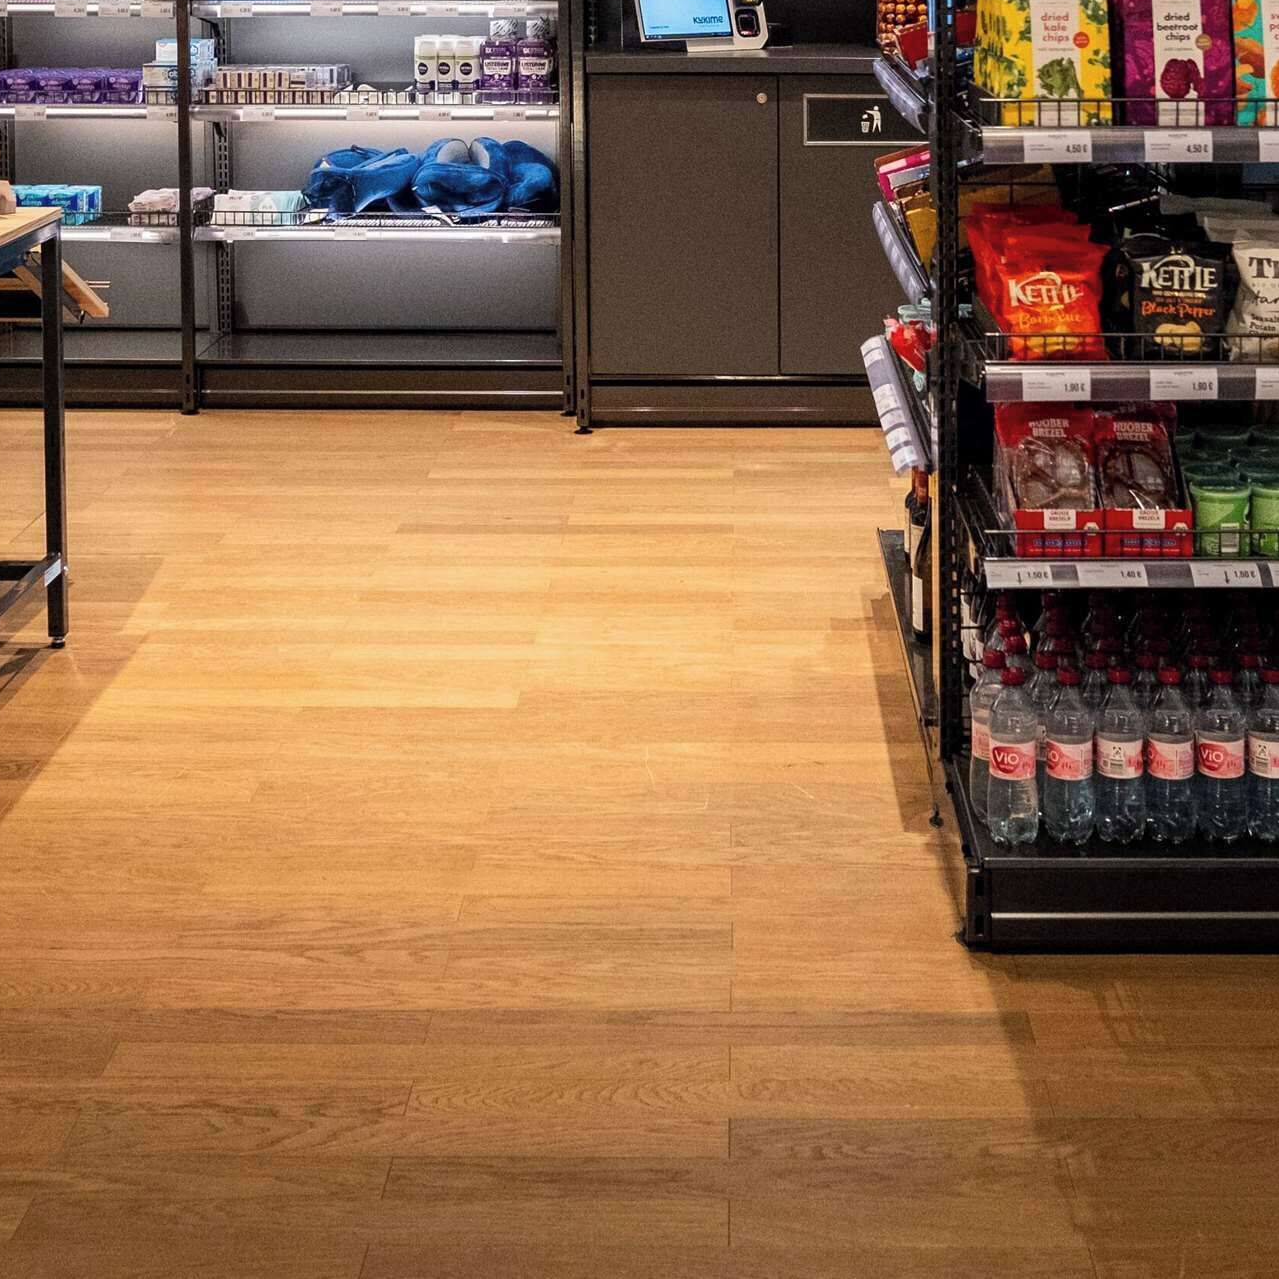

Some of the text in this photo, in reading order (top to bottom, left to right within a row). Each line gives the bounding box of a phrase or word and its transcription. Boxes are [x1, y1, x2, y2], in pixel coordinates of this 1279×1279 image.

[1041, 12, 1069, 21] dried
[1164, 12, 1190, 21] dried
[1156, 23, 1198, 31] beetroot
[1042, 33, 1070, 43] chips
[1165, 33, 1191, 42] chips
[1141, 254, 1218, 291] KETTLE
